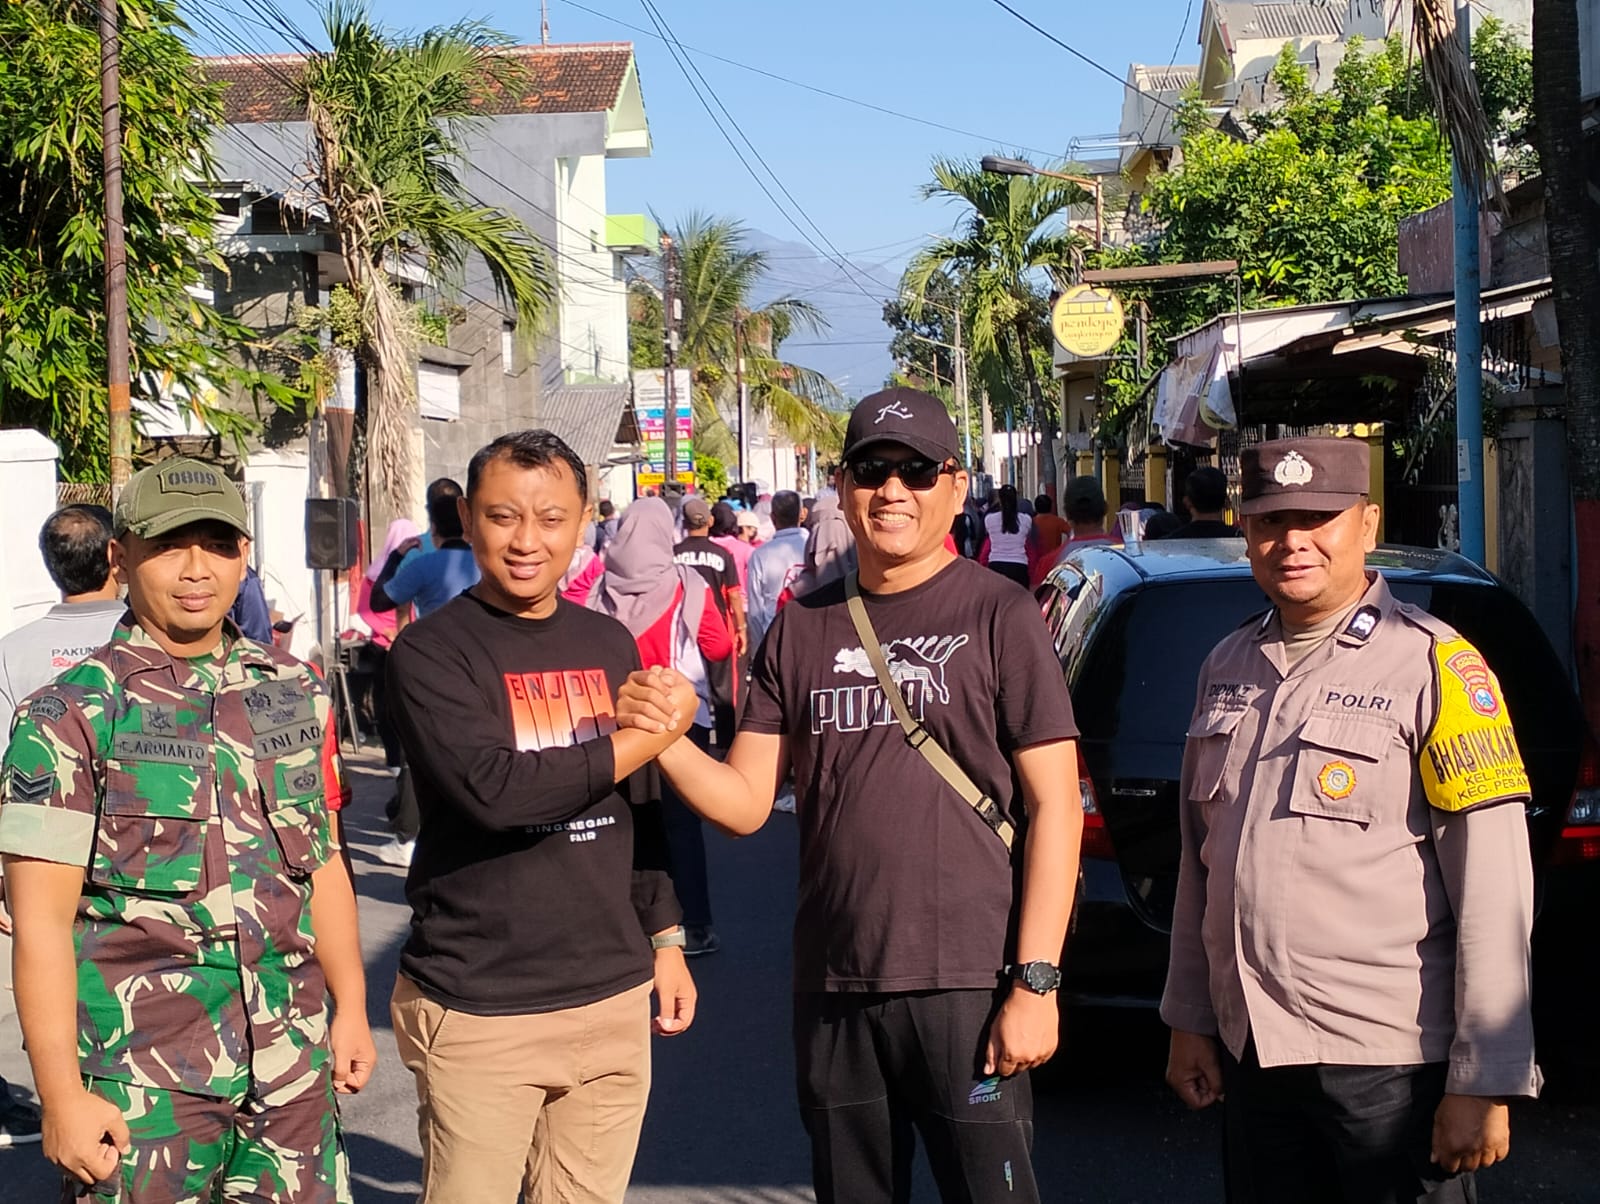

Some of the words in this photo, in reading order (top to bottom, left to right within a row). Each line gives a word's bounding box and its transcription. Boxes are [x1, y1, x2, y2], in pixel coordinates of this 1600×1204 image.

[168, 470, 217, 486] 0809
[673, 551, 725, 571] NGLAND
[51, 645, 99, 657] PAKUN
[509, 673, 604, 700] ENJOY
[1325, 691, 1392, 711] POLRI
[261, 733, 292, 753] TNI
[300, 726, 320, 743] AD
[569, 831, 597, 842] FAIR
[968, 1091, 1002, 1105] SPORT
